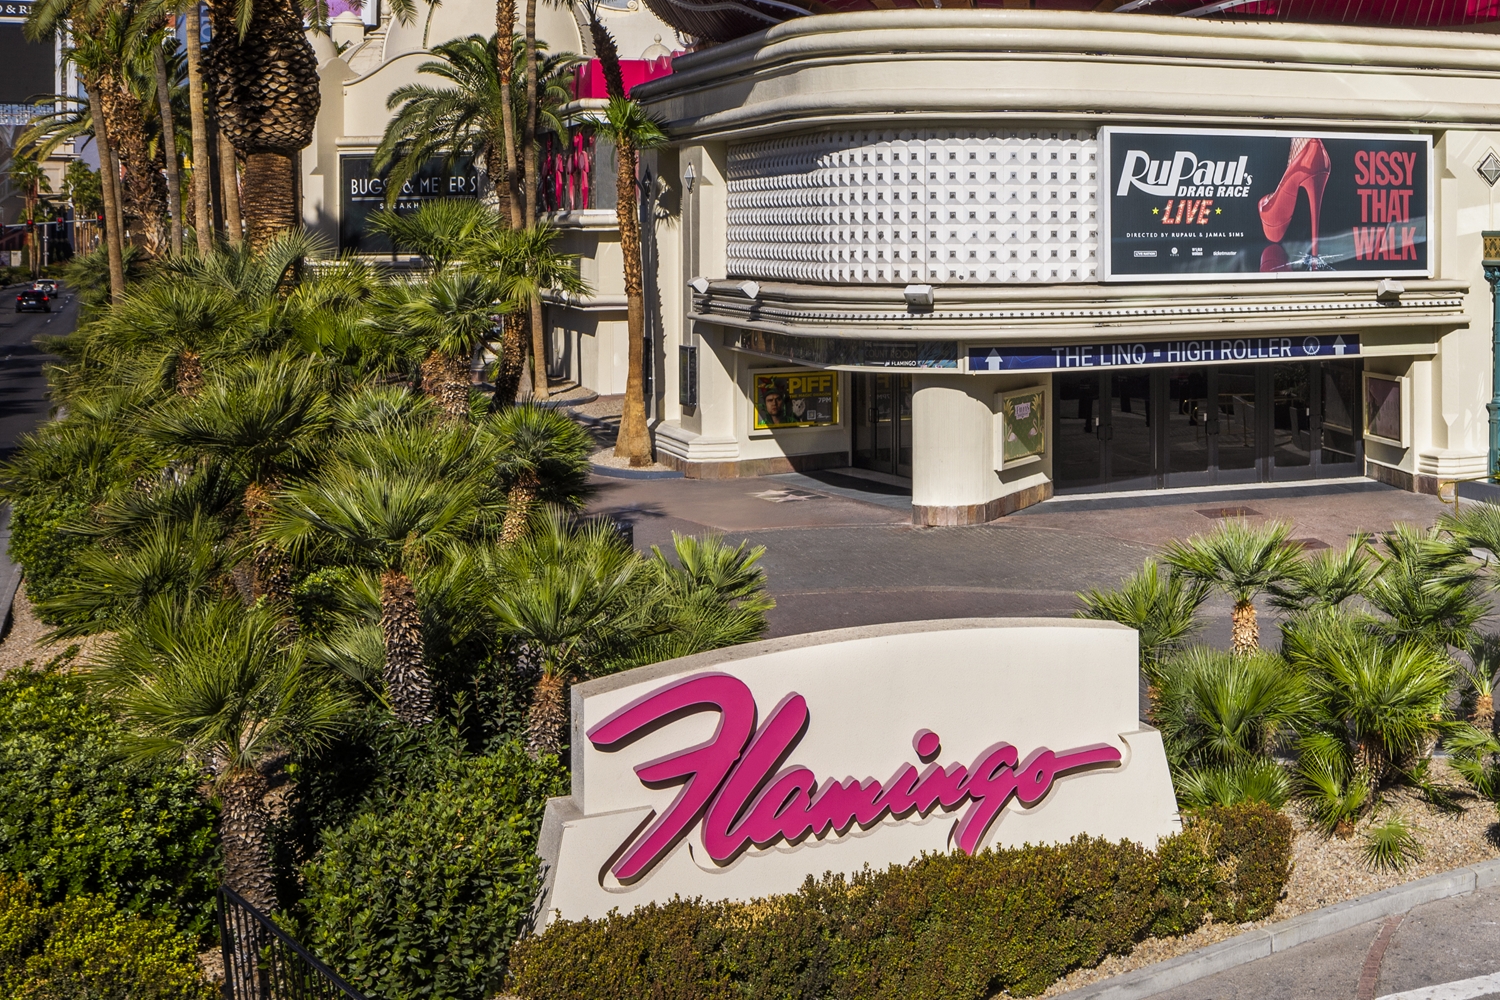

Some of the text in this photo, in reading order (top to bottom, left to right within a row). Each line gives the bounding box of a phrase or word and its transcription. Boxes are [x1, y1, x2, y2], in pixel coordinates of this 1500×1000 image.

[1117, 150, 1254, 197] RuPaul's
[1354, 150, 1417, 186] SISSY
[420, 176, 476, 194] MEER'S
[1177, 186, 1250, 198] DRAG RACE
[1162, 199, 1214, 225] LIVE
[1357, 188, 1414, 223] THAT
[1353, 226, 1418, 261] WALK
[864, 348, 917, 359] COUNT ROOM
[1052, 338, 1292, 368] THE LINQ HIGH ROLLER
[789, 376, 831, 394] PIFF
[586, 672, 1121, 882] Flamingo
